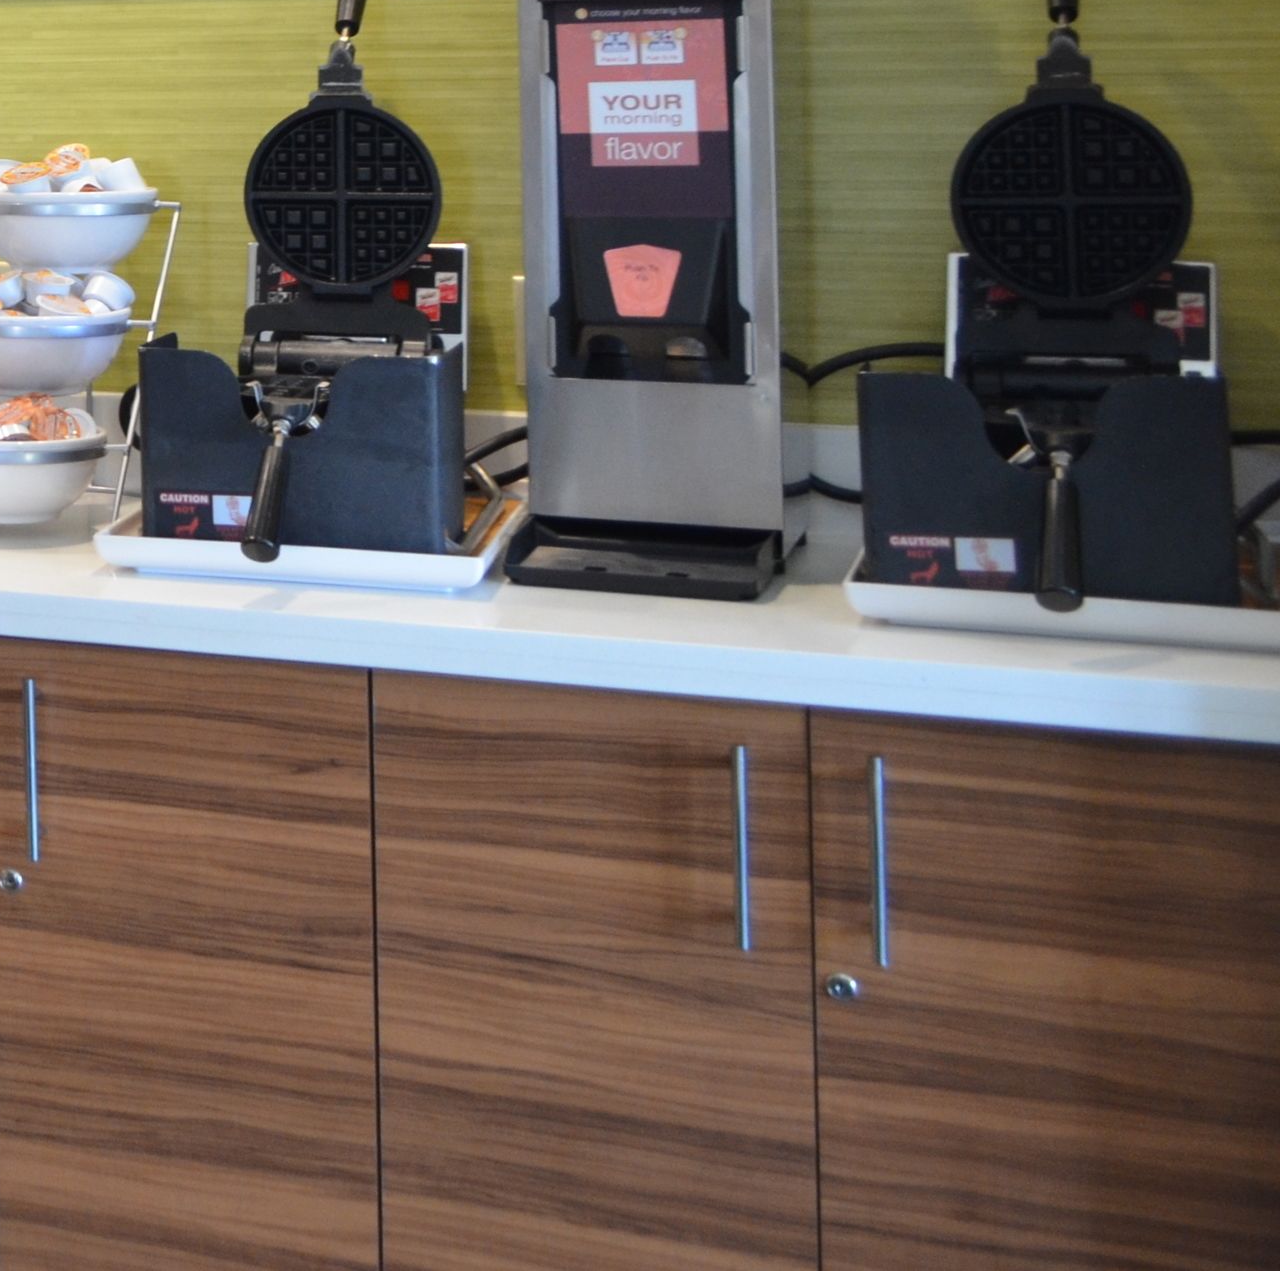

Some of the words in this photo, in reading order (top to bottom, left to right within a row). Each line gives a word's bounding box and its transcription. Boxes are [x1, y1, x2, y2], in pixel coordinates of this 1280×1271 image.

[602, 94, 682, 111] YOUR
[604, 112, 683, 127] morning
[604, 137, 683, 160] flavor
[160, 492, 210, 505] CAUTION
[174, 505, 195, 514] HOT
[889, 535, 951, 548] CAUTION
